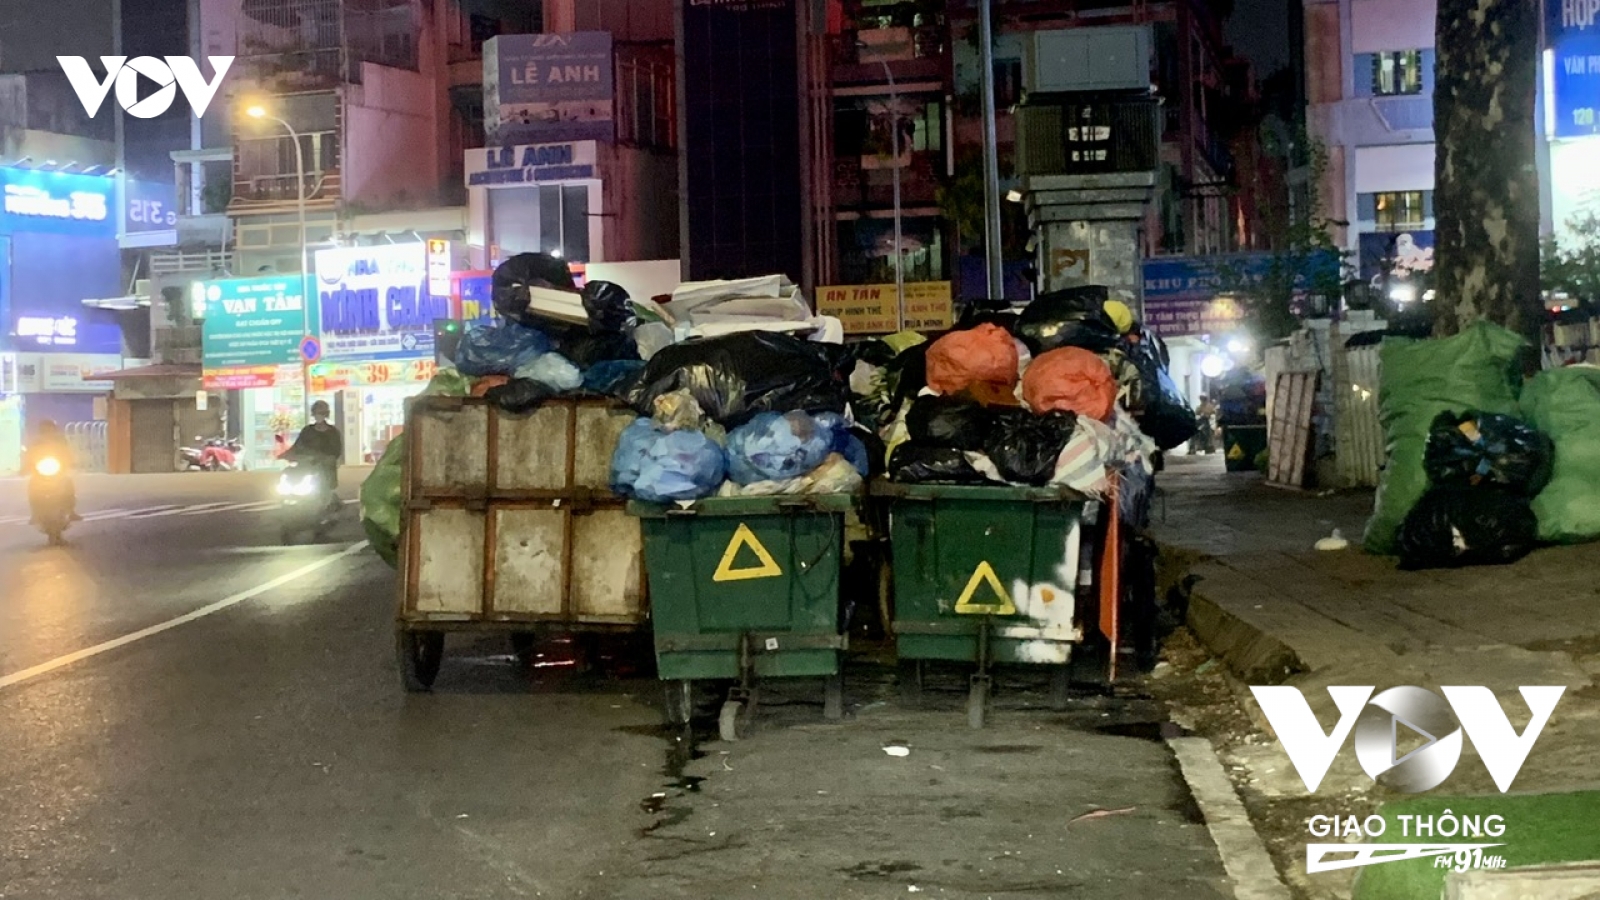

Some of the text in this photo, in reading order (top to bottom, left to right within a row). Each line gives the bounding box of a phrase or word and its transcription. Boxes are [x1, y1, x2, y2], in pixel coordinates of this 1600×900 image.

[510, 61, 600, 84] LÊ ANH
[522, 144, 573, 166] ANH
[222, 292, 302, 317] VẠN TÂM
[826, 290, 847, 301] AN
[367, 364, 389, 383] 39
